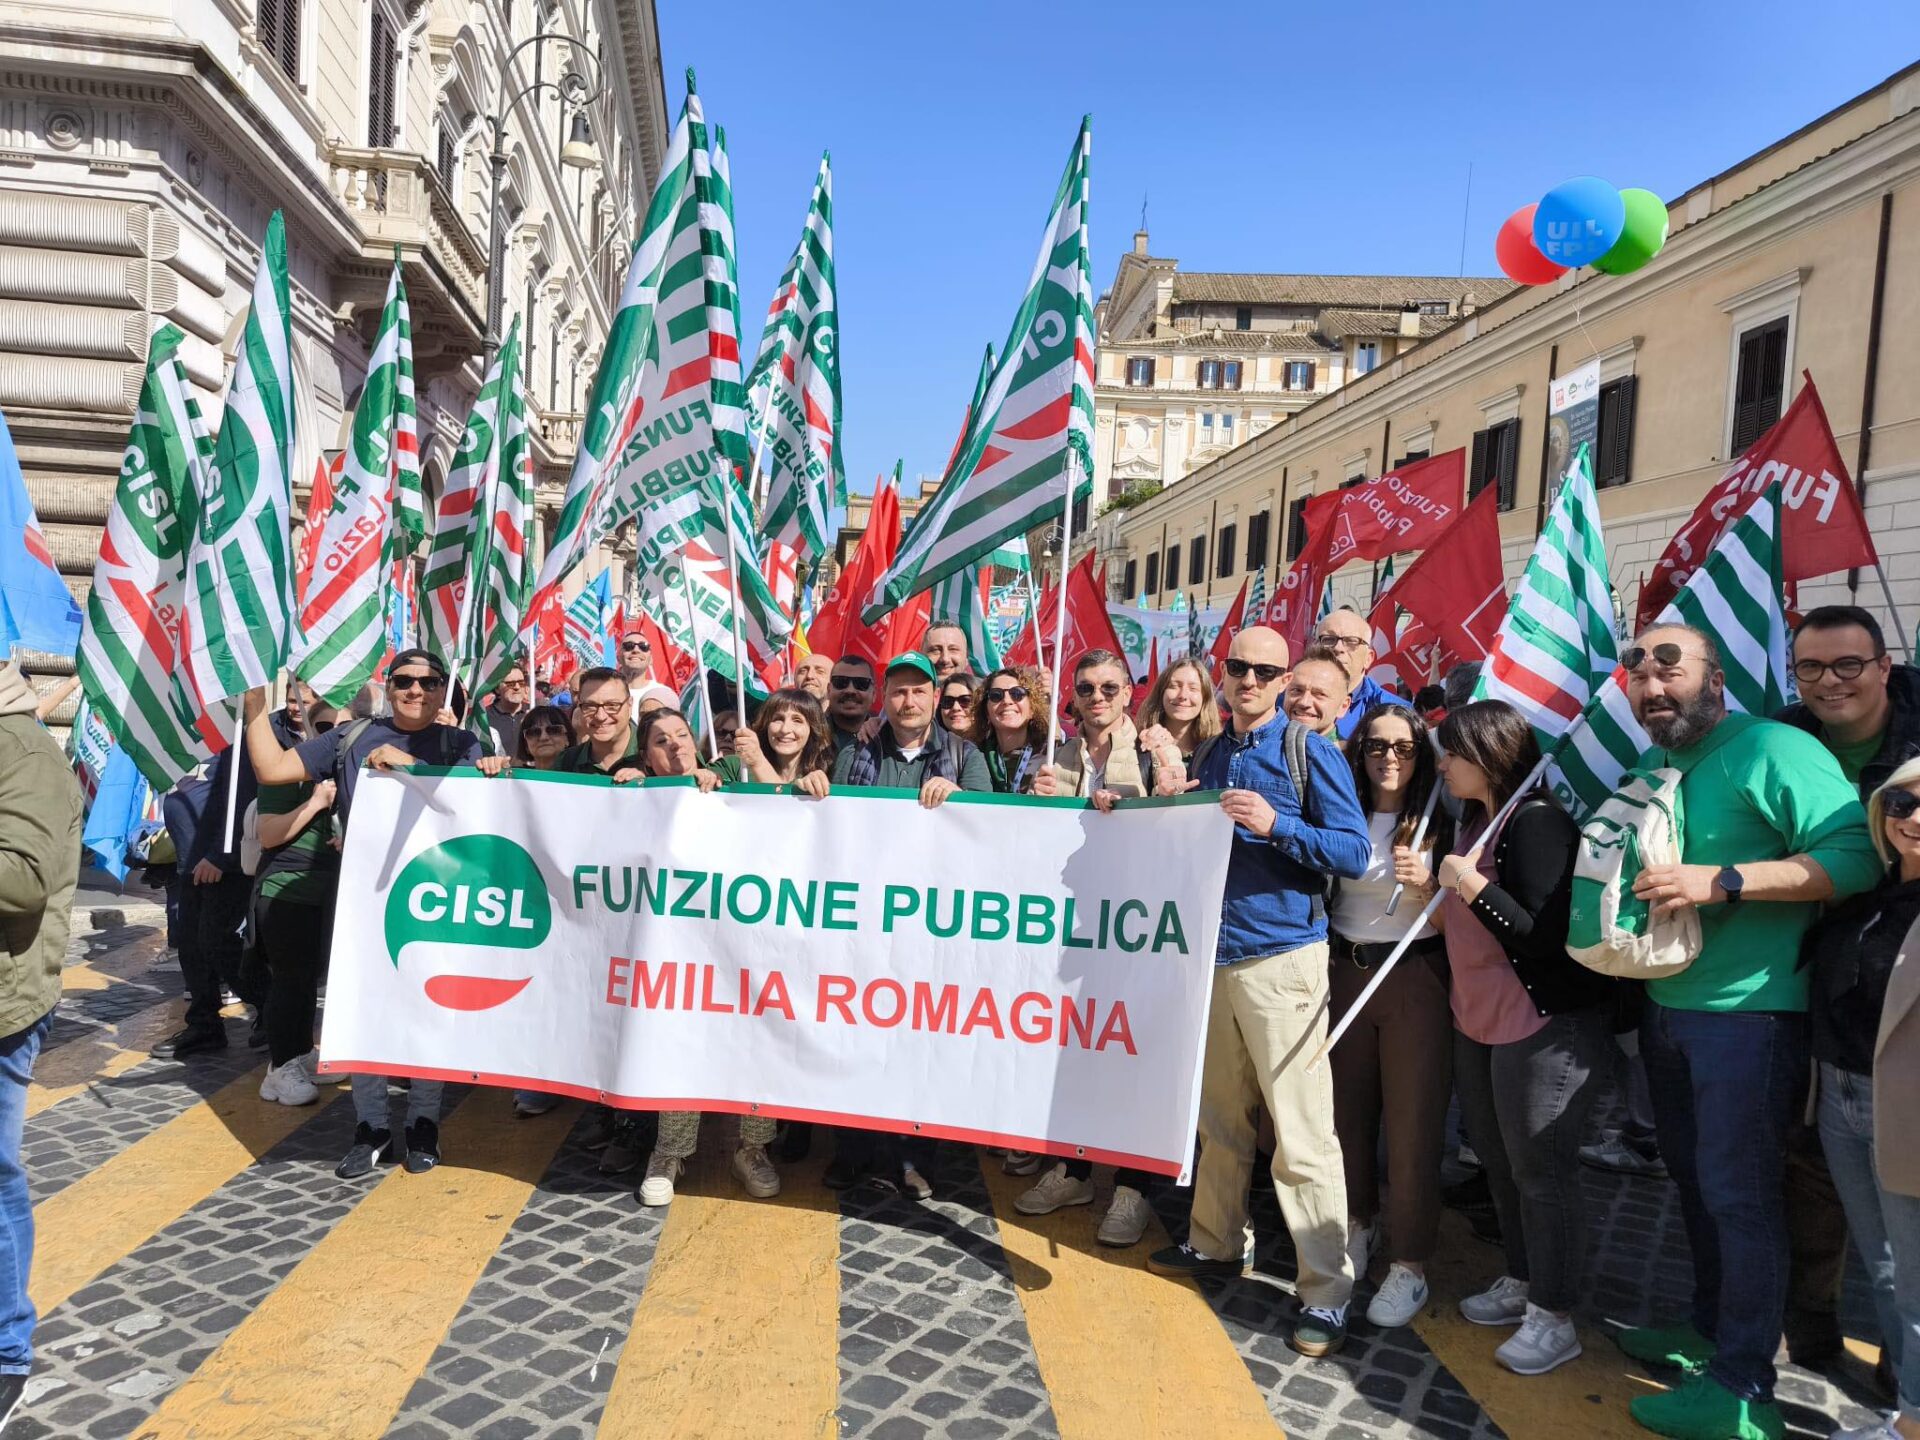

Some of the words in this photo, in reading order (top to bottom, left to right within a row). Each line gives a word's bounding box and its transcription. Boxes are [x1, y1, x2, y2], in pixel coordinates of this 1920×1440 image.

[1547, 219, 1603, 240] UIL
[120, 444, 178, 546] CISL
[408, 881, 535, 929] CISL
[573, 865, 859, 931] FUNZIONE
[881, 884, 1189, 955] PUBBLICA
[606, 956, 796, 1022] EMILIA
[816, 974, 1138, 1057] ROMAGNA
